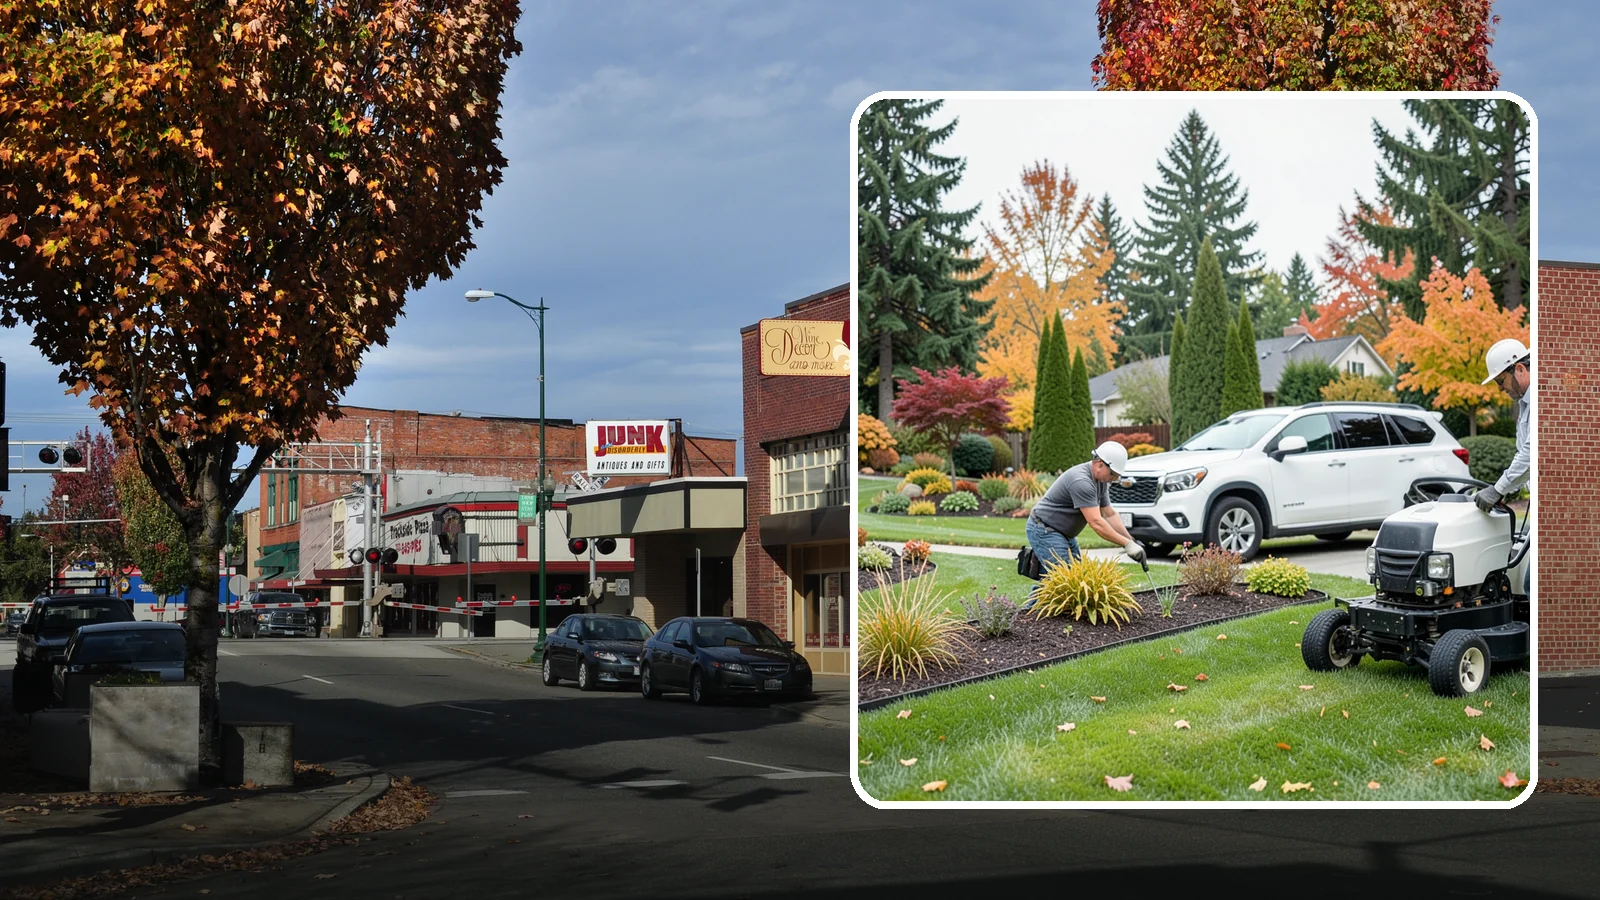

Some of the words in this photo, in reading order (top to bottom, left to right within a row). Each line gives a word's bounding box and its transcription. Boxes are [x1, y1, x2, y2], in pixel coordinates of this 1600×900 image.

[595, 425, 665, 457] JUNK
[607, 446, 646, 454] DISORDERLY
[597, 461, 628, 470] ANTIQUES
[631, 461, 644, 469] AND
[647, 460, 665, 470] GIFTS
[414, 519, 429, 535] Pizza
